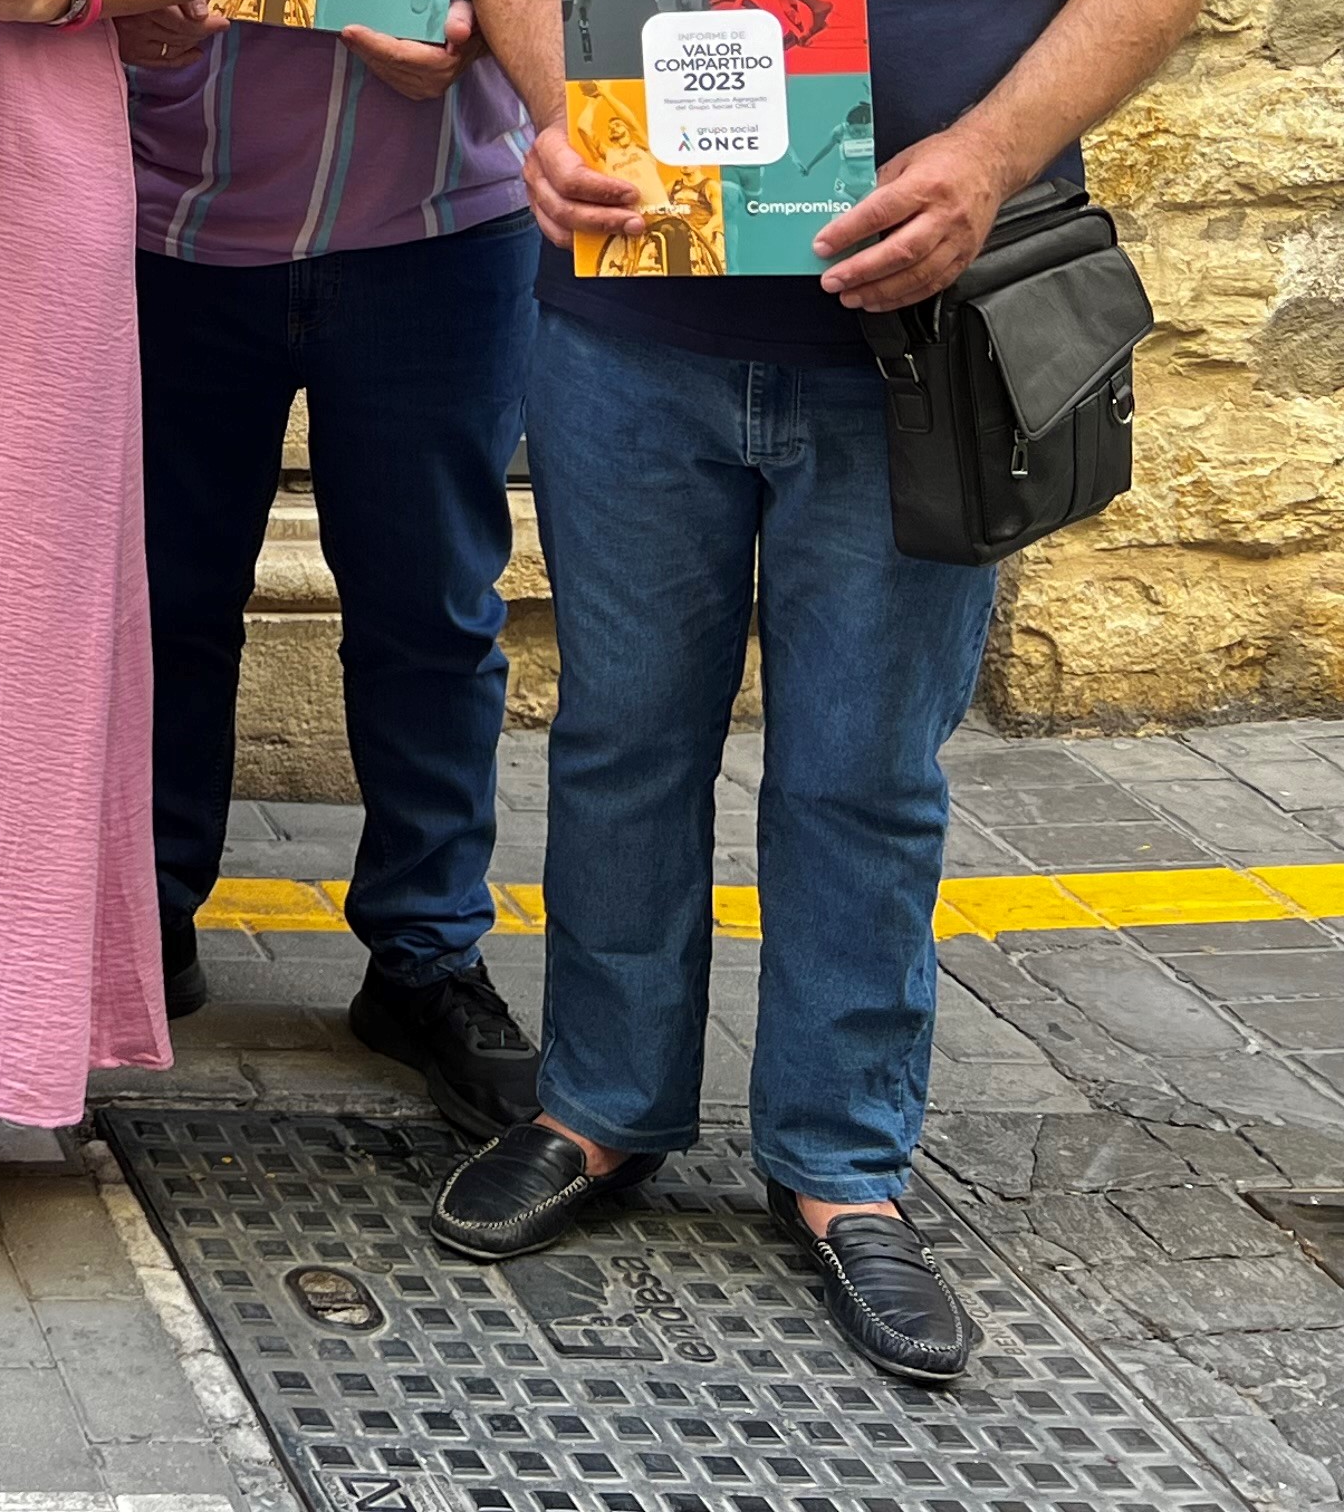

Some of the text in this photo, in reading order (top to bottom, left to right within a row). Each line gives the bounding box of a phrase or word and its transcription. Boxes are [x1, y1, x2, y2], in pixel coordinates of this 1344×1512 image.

[682, 43, 742, 57] VALOR
[654, 56, 773, 72] COMPARTIDO
[684, 72, 746, 91] 2023
[697, 126, 728, 135] grupo
[698, 136, 759, 151] ONCE
[747, 199, 852, 215] Compromiso
